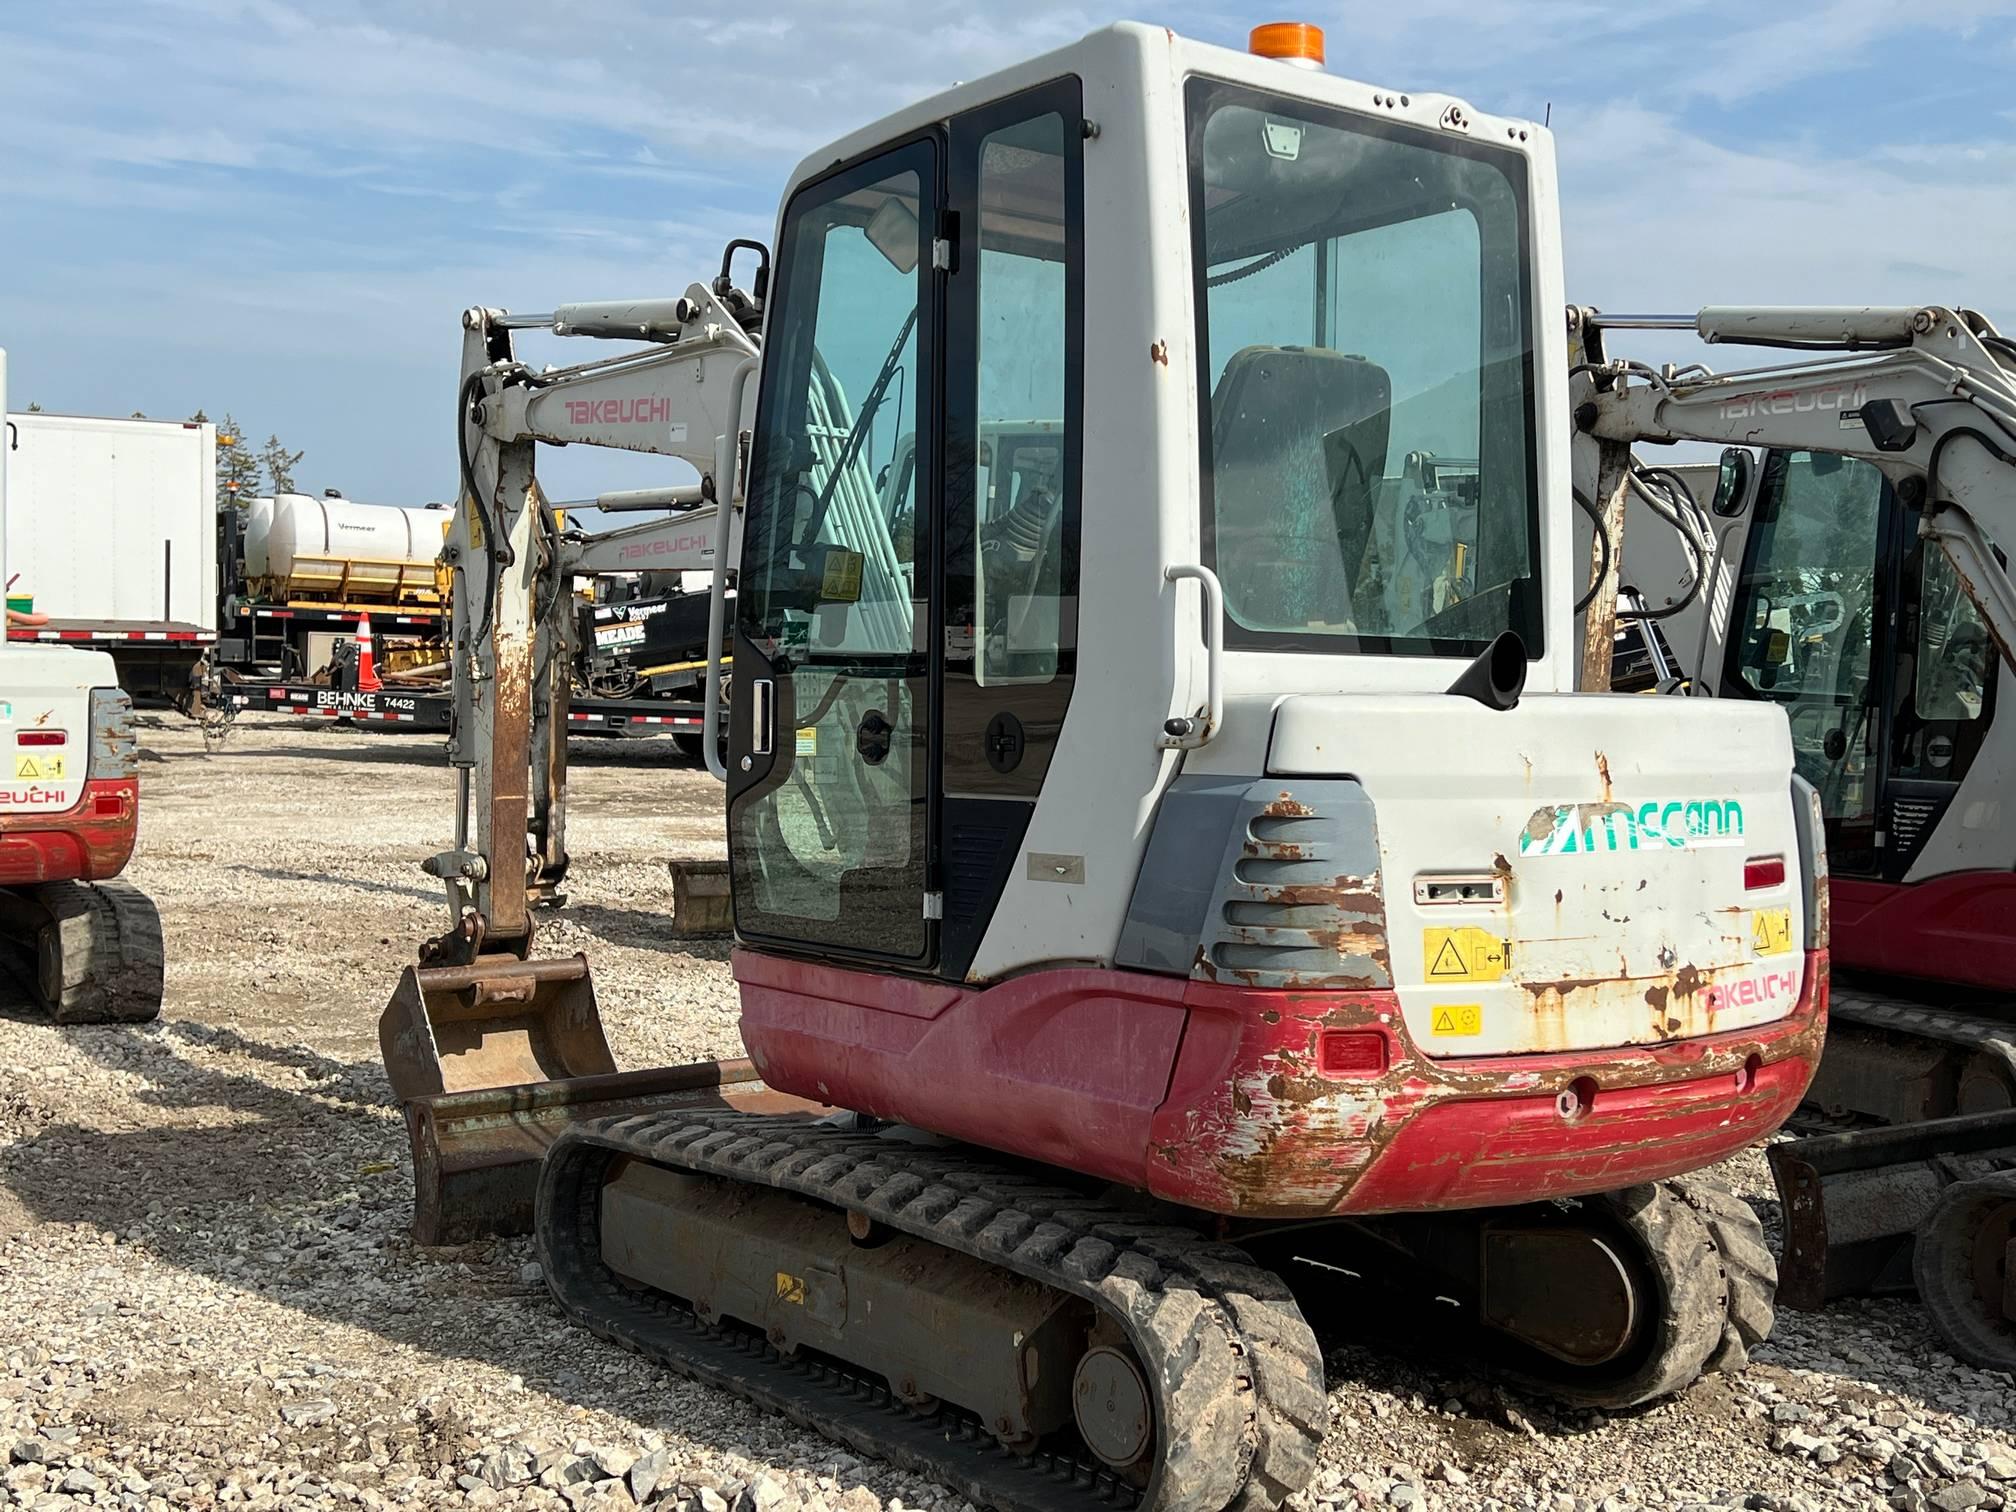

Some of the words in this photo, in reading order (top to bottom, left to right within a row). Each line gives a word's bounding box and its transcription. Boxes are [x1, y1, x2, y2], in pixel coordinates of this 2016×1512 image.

[565, 397, 671, 425] TAKEUCHI
[594, 624, 646, 647] MEADE
[317, 691, 376, 707] BEHNKE
[384, 697, 415, 710] 74422
